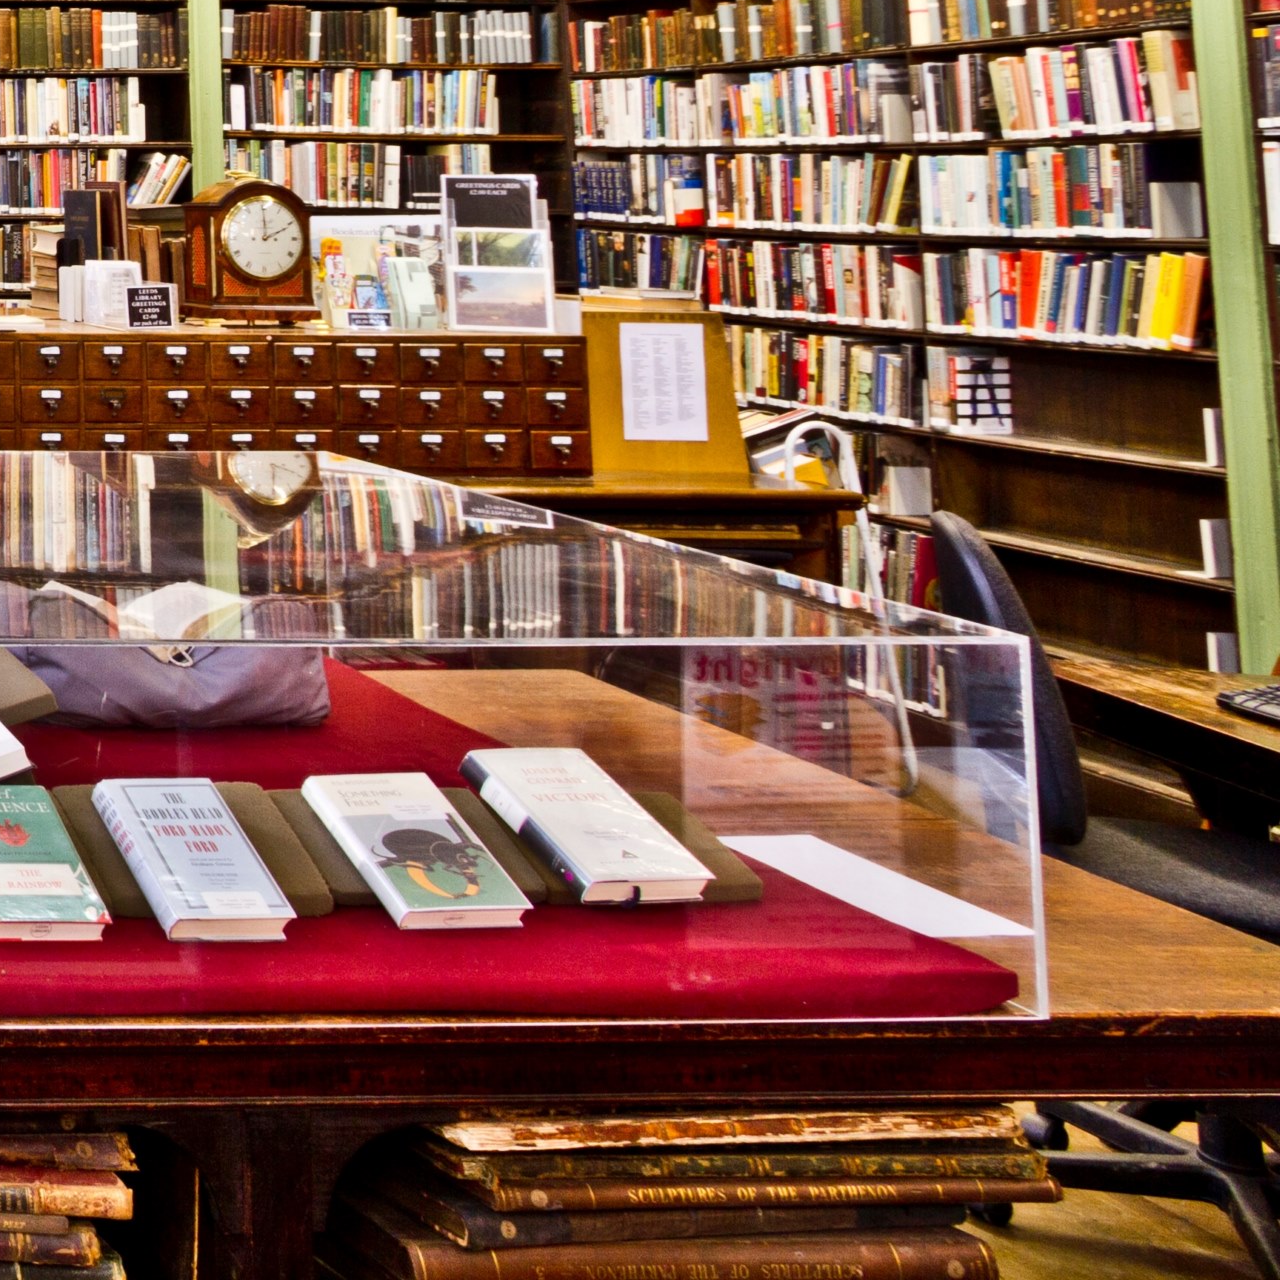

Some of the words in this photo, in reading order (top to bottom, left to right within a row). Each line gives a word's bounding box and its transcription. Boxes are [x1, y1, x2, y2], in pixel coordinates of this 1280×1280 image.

[521, 767, 568, 777] JOSEPH
[526, 776, 582, 784] CONRAD
[161, 793, 186, 804] THE
[337, 789, 402, 798] SOMETHING
[532, 792, 608, 803] VICTORY
[142, 808, 188, 820] BODLEY
[191, 808, 223, 819] HEAD
[153, 824, 186, 837] FORD
[191, 824, 232, 837] MADOX
[184, 841, 219, 853] FORD
[17, 868, 42, 878] THE
[8, 879, 62, 889] RAINBOW
[627, 1185, 727, 1205] SCULPTURES
[737, 1185, 757, 1202] OF
[766, 1185, 799, 1202] THE
[808, 1184, 898, 1202] PARTHENON
